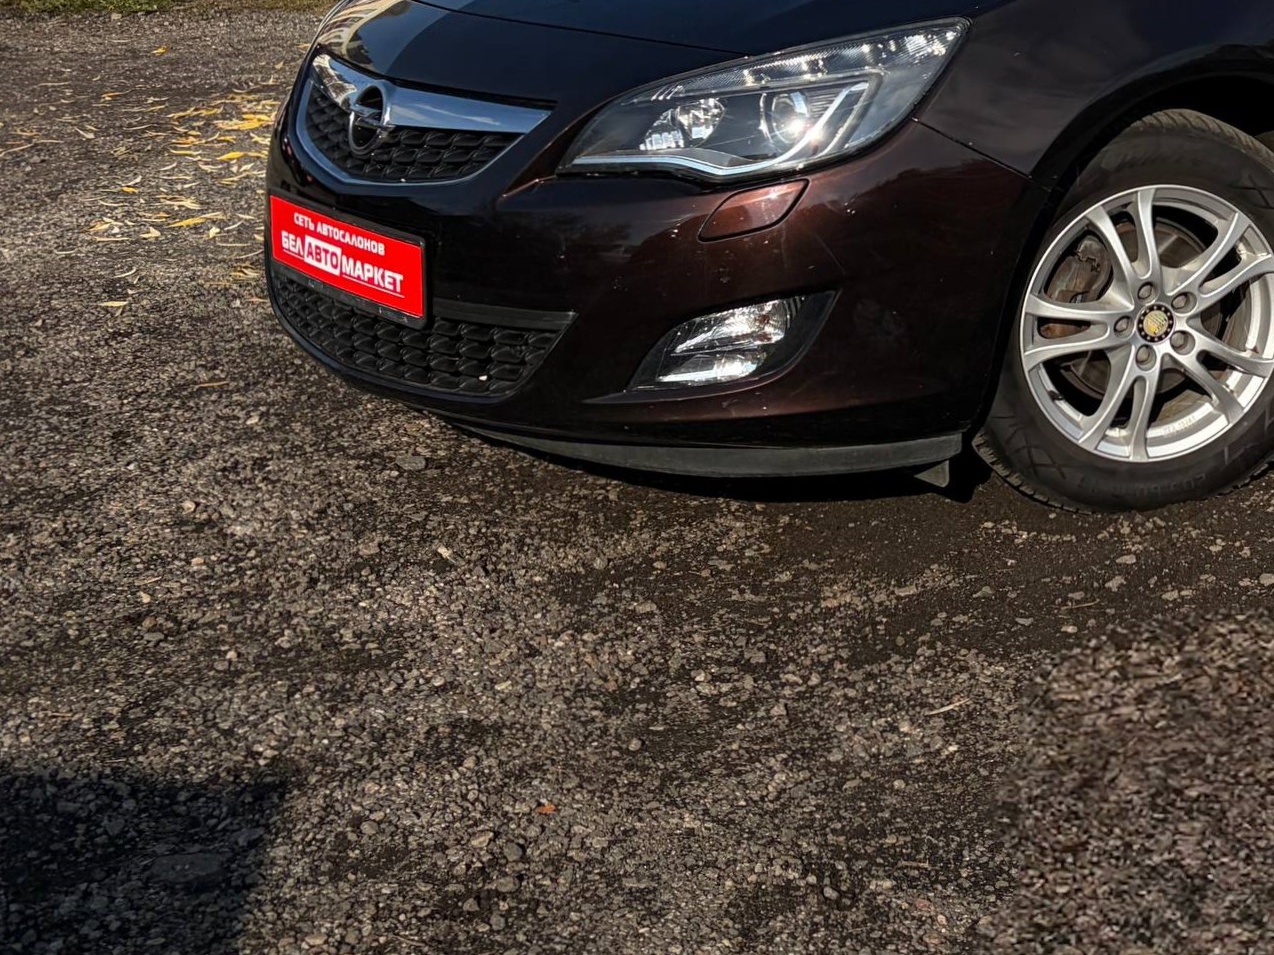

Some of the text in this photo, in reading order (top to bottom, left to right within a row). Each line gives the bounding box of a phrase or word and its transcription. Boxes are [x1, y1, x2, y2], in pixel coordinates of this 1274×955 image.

[294, 212, 385, 256] СЕТЬ АВТОСАЛОНОВ
[342, 255, 403, 293] МАРКЕТ
